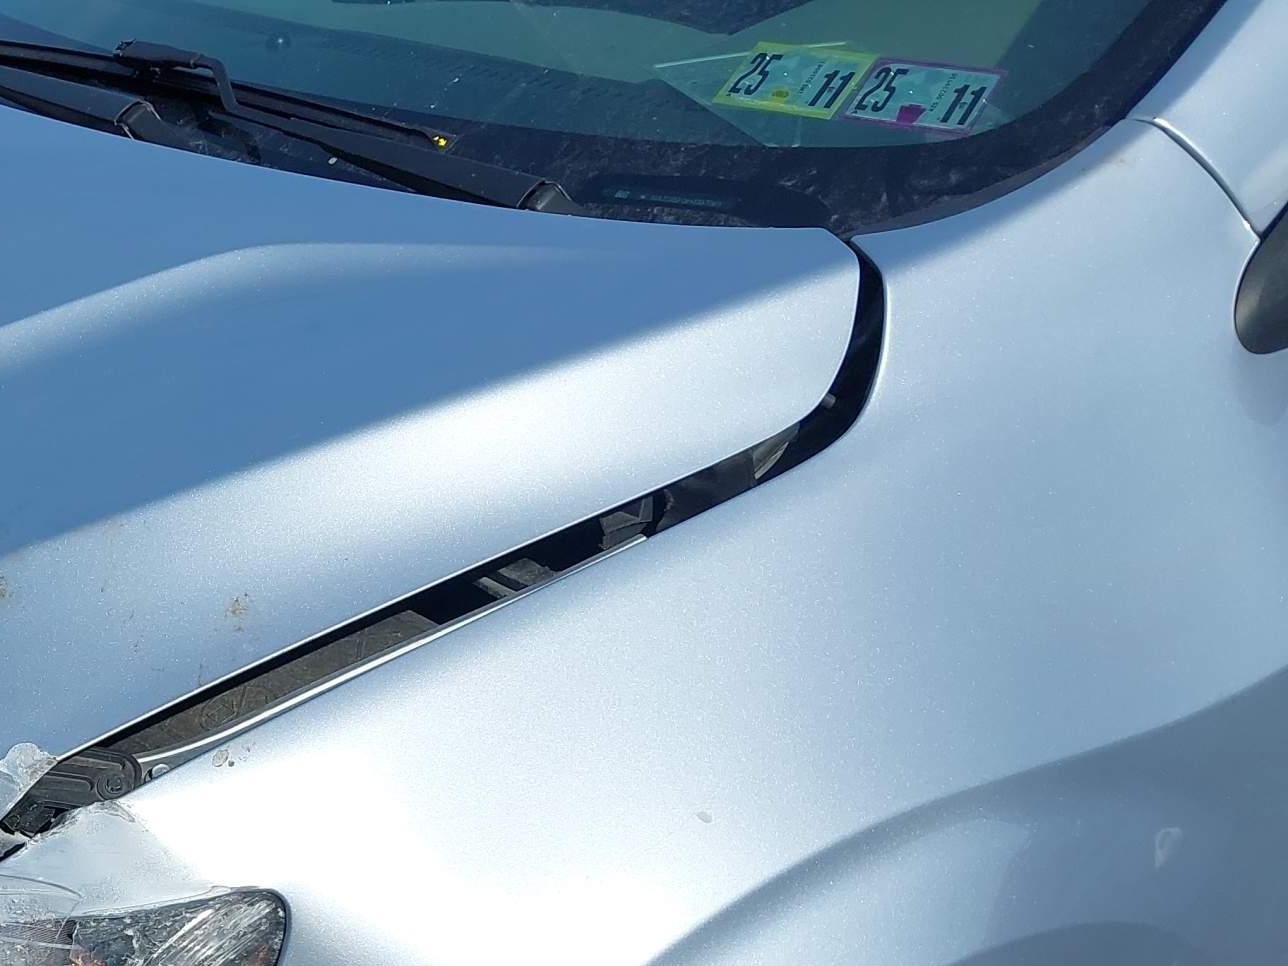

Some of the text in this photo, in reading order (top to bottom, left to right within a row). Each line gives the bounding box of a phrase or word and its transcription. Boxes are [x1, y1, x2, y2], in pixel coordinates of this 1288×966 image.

[728, 52, 784, 96] 25
[808, 69, 856, 109] 11
[855, 66, 910, 112] 25
[940, 84, 987, 126] 11
